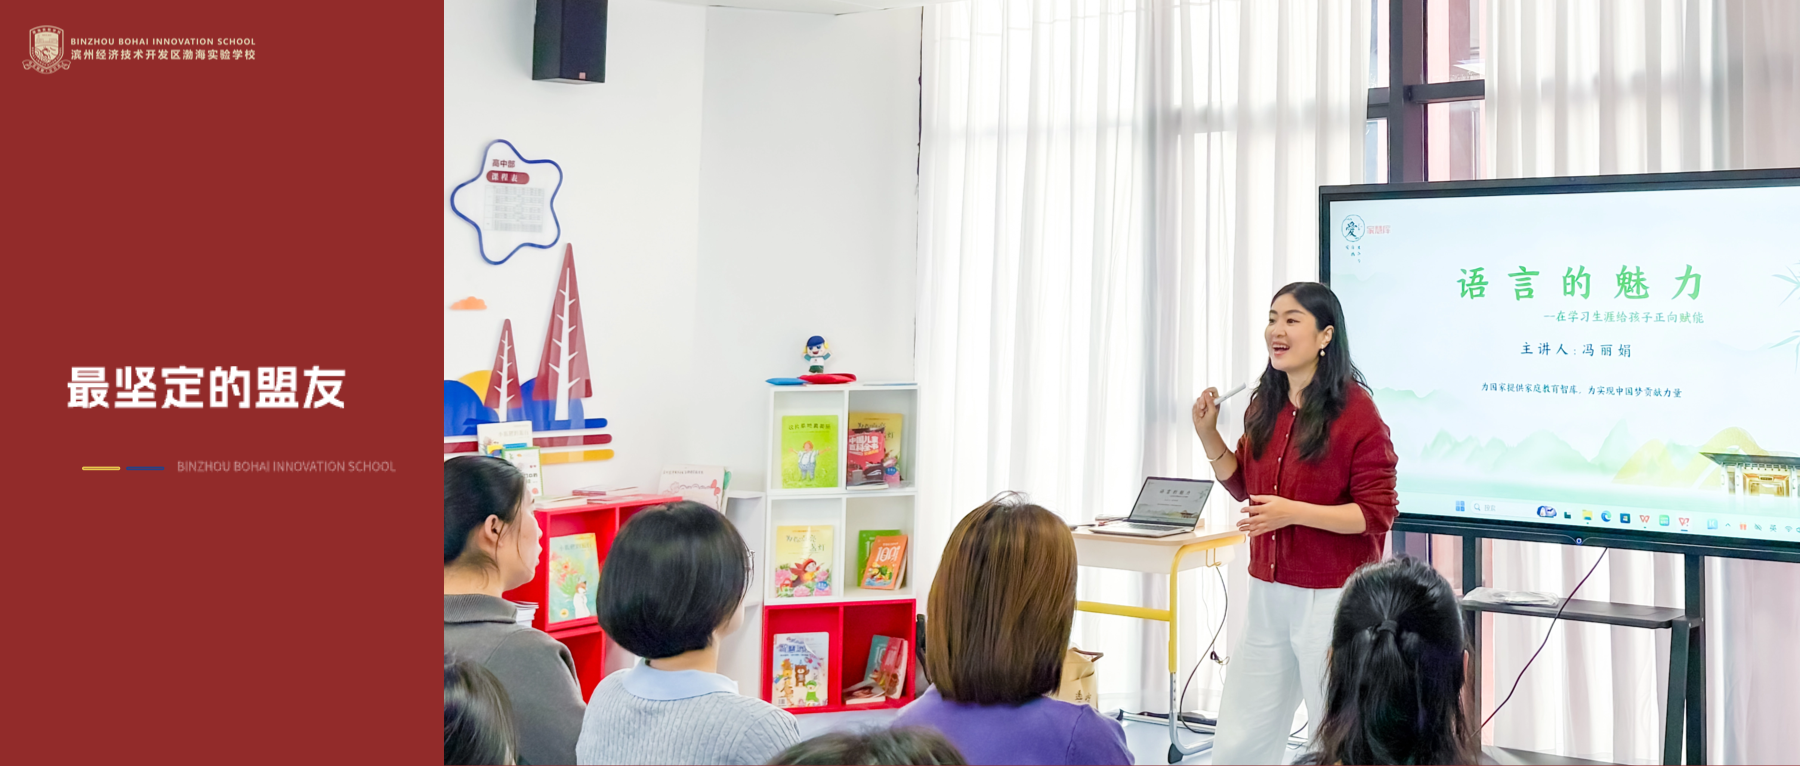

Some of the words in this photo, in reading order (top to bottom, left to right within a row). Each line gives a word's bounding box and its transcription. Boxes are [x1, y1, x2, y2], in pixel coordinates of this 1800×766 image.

[492, 159, 516, 168] 高中部
[1456, 263, 1702, 302] 语言的魅力
